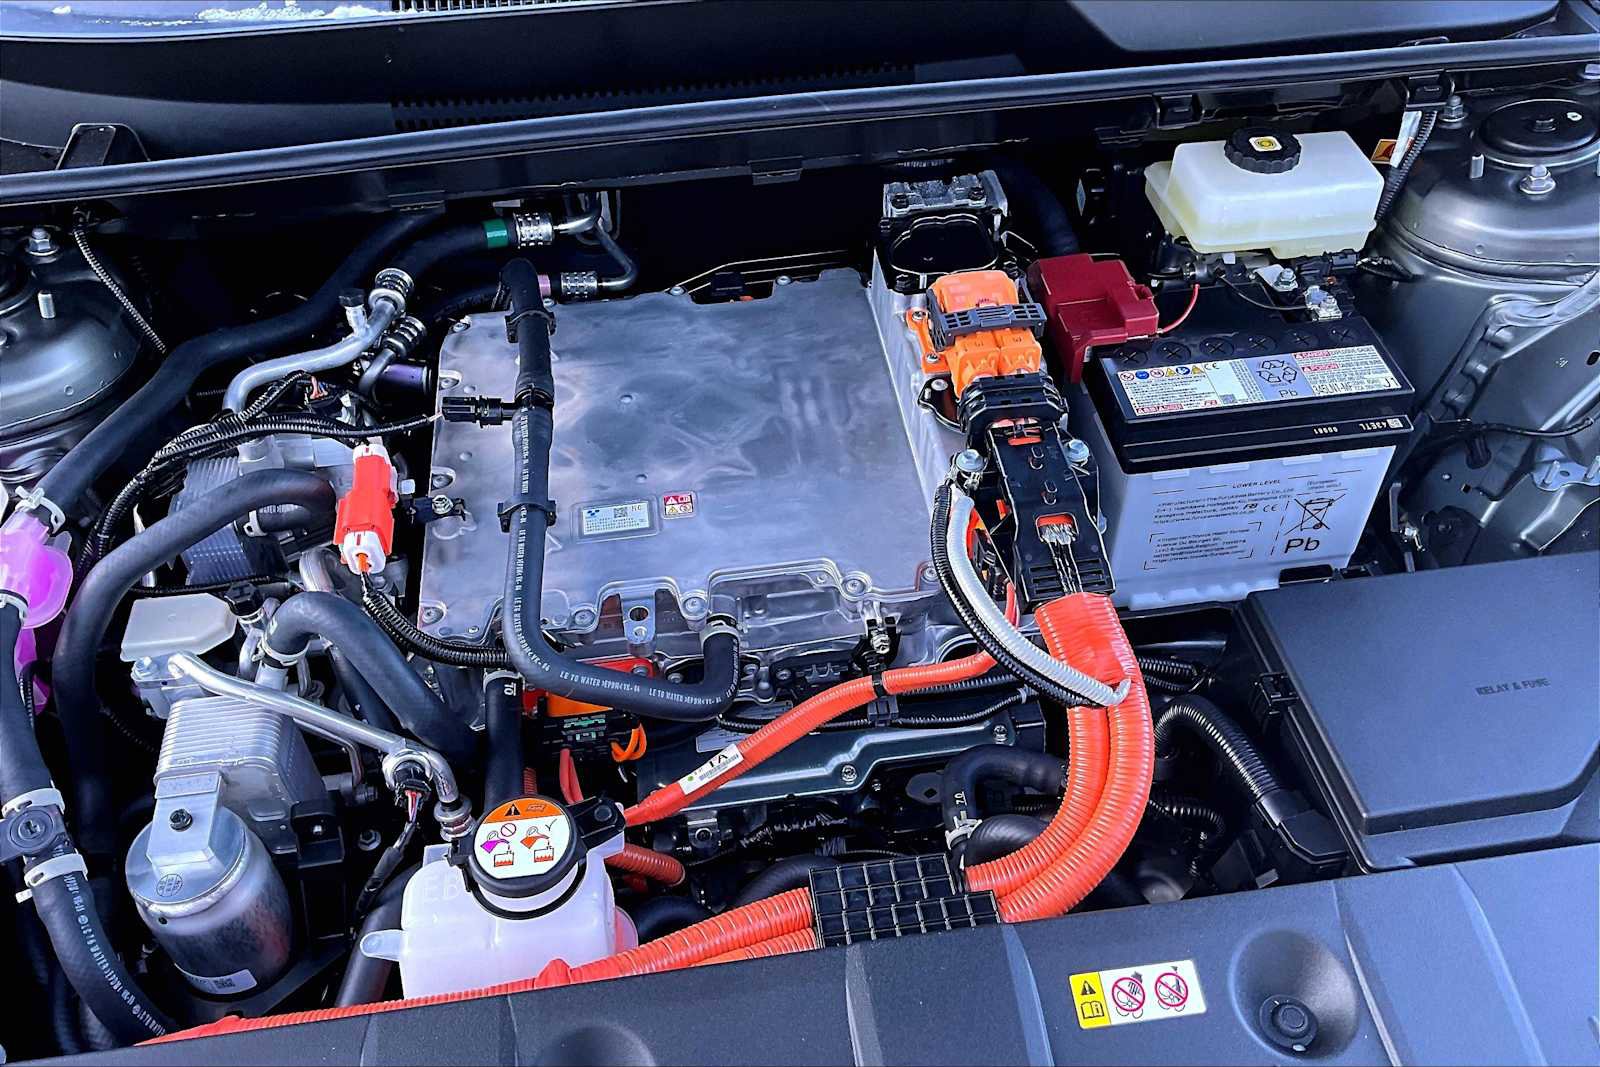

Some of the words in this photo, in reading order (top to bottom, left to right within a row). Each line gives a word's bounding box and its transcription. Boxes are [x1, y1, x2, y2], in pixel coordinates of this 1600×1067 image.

[1279, 389, 1298, 398] Pb
[1232, 481, 1258, 489] LOWER
[1259, 479, 1281, 487] LEVEL
[1262, 504, 1279, 513] CE
[1284, 537, 1320, 554] Pb
[559, 670, 570, 680] LE
[570, 673, 579, 683] TO
[580, 676, 601, 687] WATER
[648, 687, 657, 697] LE
[1474, 683, 1510, 696] RELAY
[1521, 678, 1551, 690] FUSE
